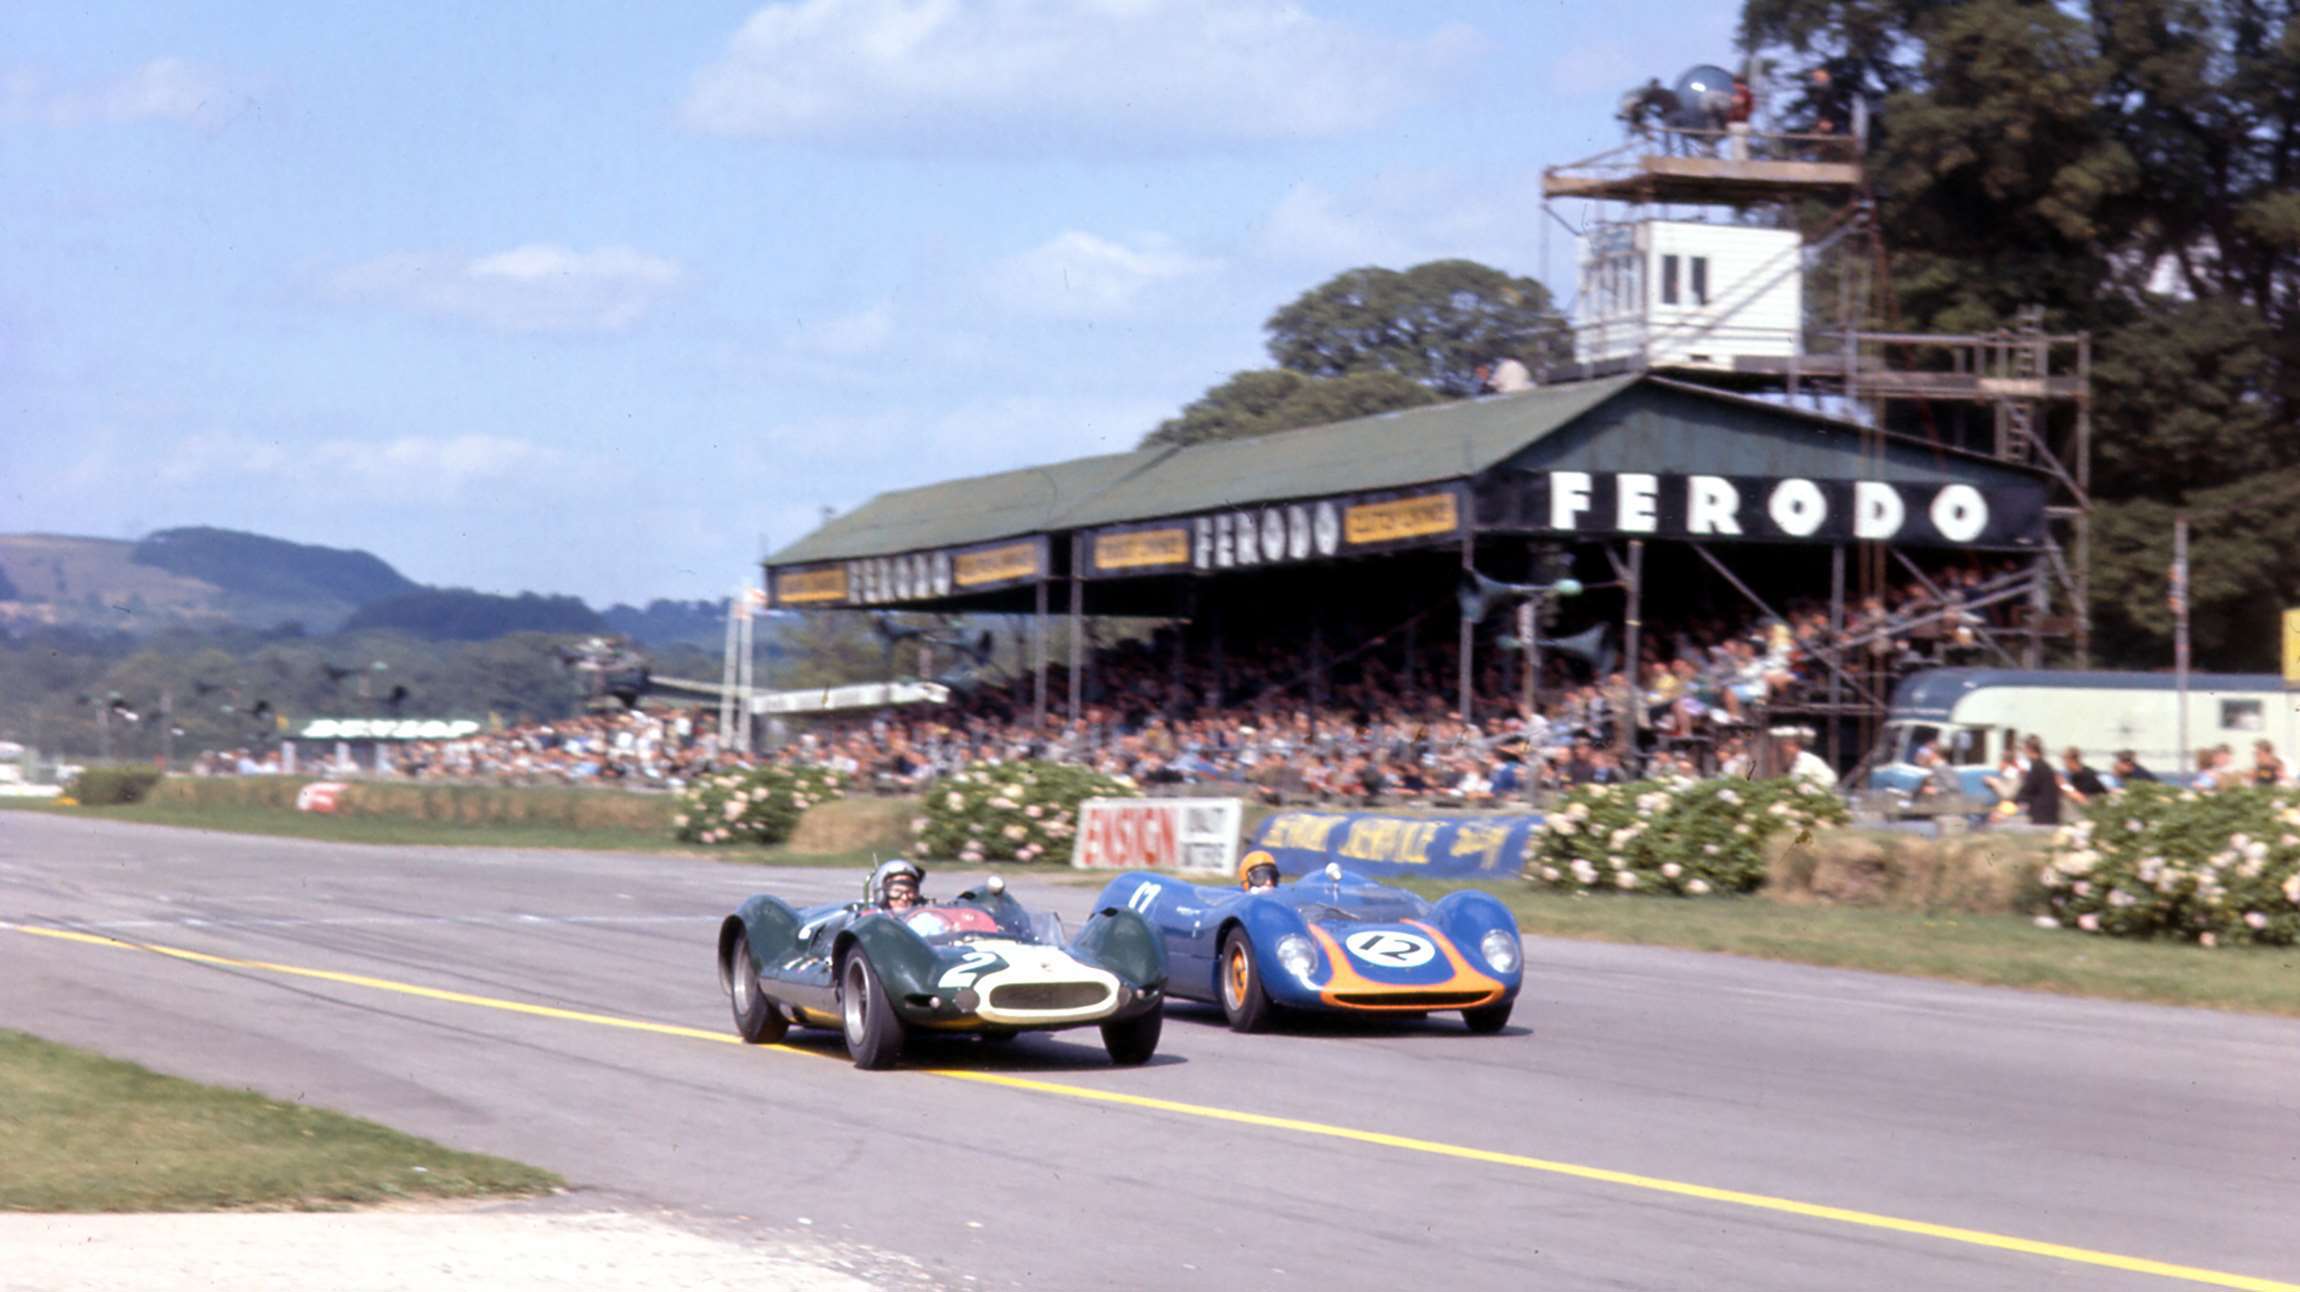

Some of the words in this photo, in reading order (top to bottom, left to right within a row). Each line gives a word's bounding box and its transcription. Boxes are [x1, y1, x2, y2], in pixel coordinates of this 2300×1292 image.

[1194, 501, 1340, 570] FERODO
[1549, 471, 1989, 542] FERODO
[1083, 807, 1179, 867] ENSIGN
[938, 951, 998, 988] 2
[1359, 935, 1422, 962] 12
